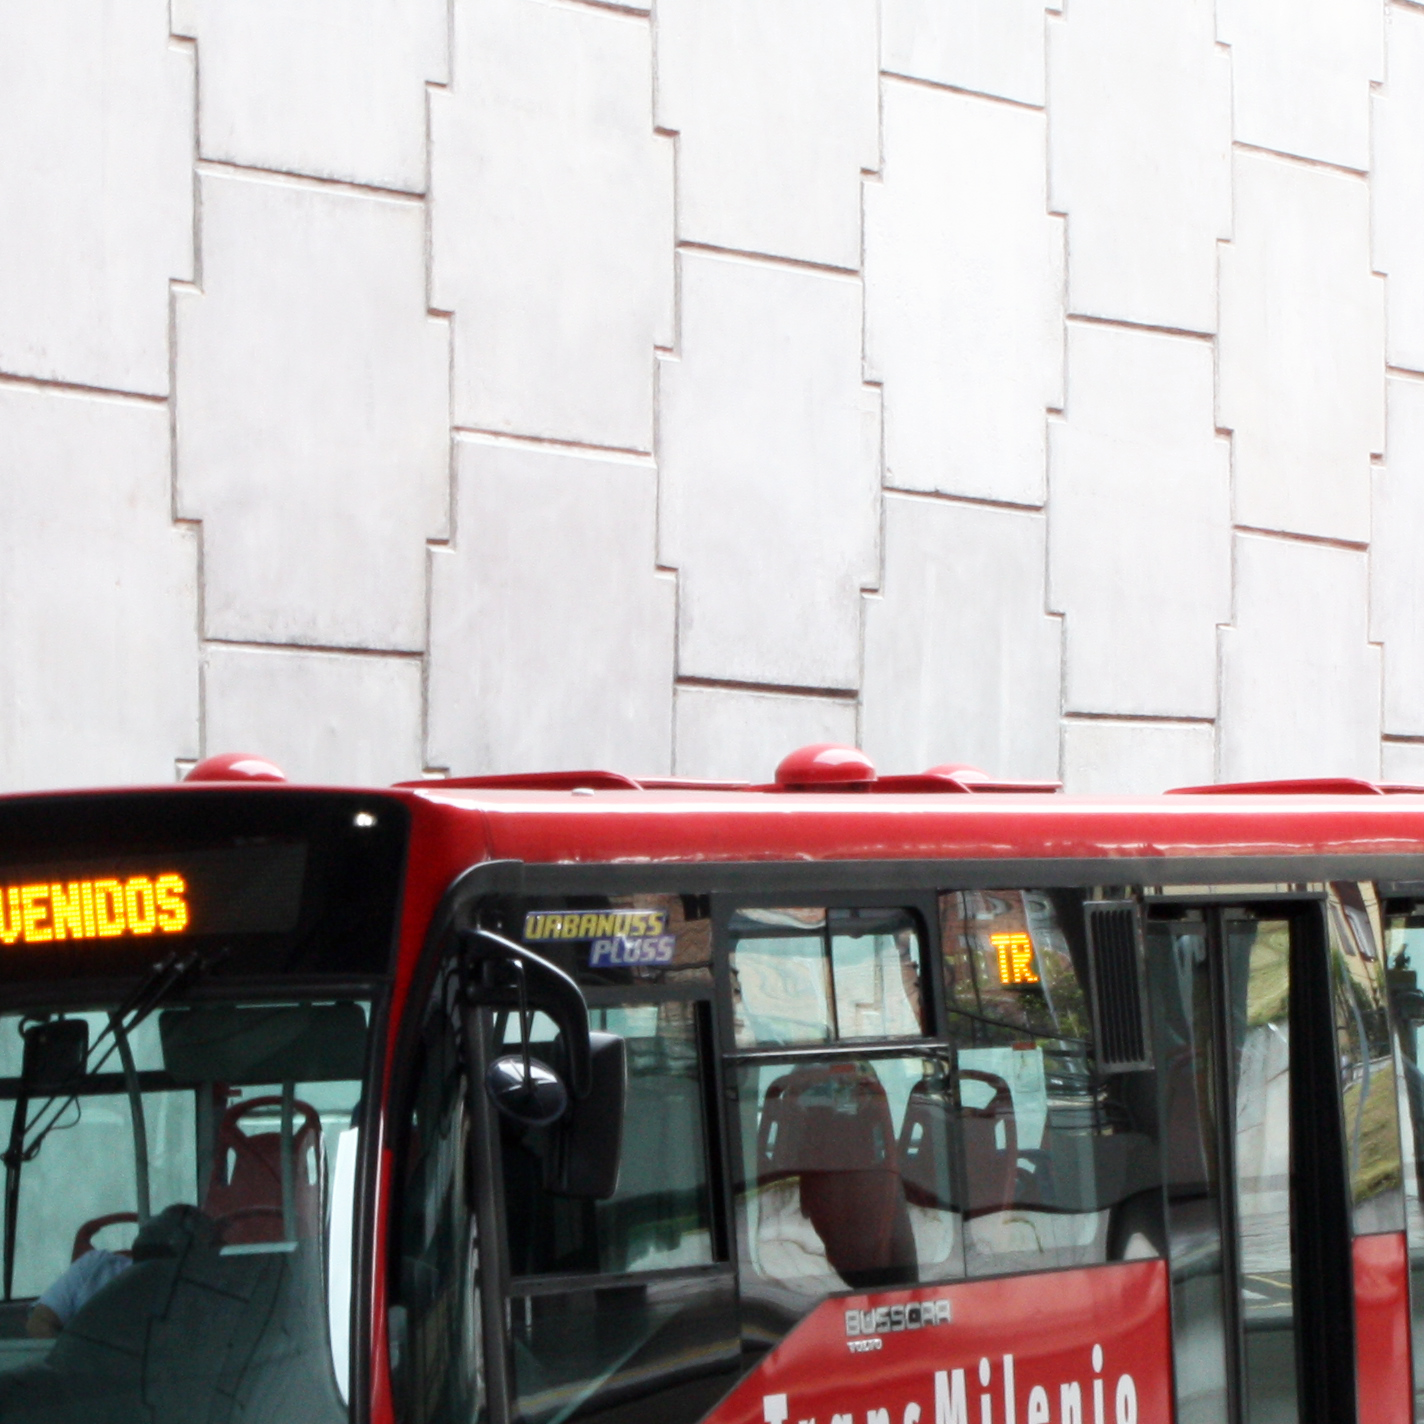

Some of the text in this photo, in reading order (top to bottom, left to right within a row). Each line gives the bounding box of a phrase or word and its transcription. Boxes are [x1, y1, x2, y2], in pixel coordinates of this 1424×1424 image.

[524, 911, 665, 940] URBANUSS
[591, 936, 675, 965] PLUSS
[988, 931, 1042, 985] TR
[845, 1299, 952, 1337] BUSSCAR
